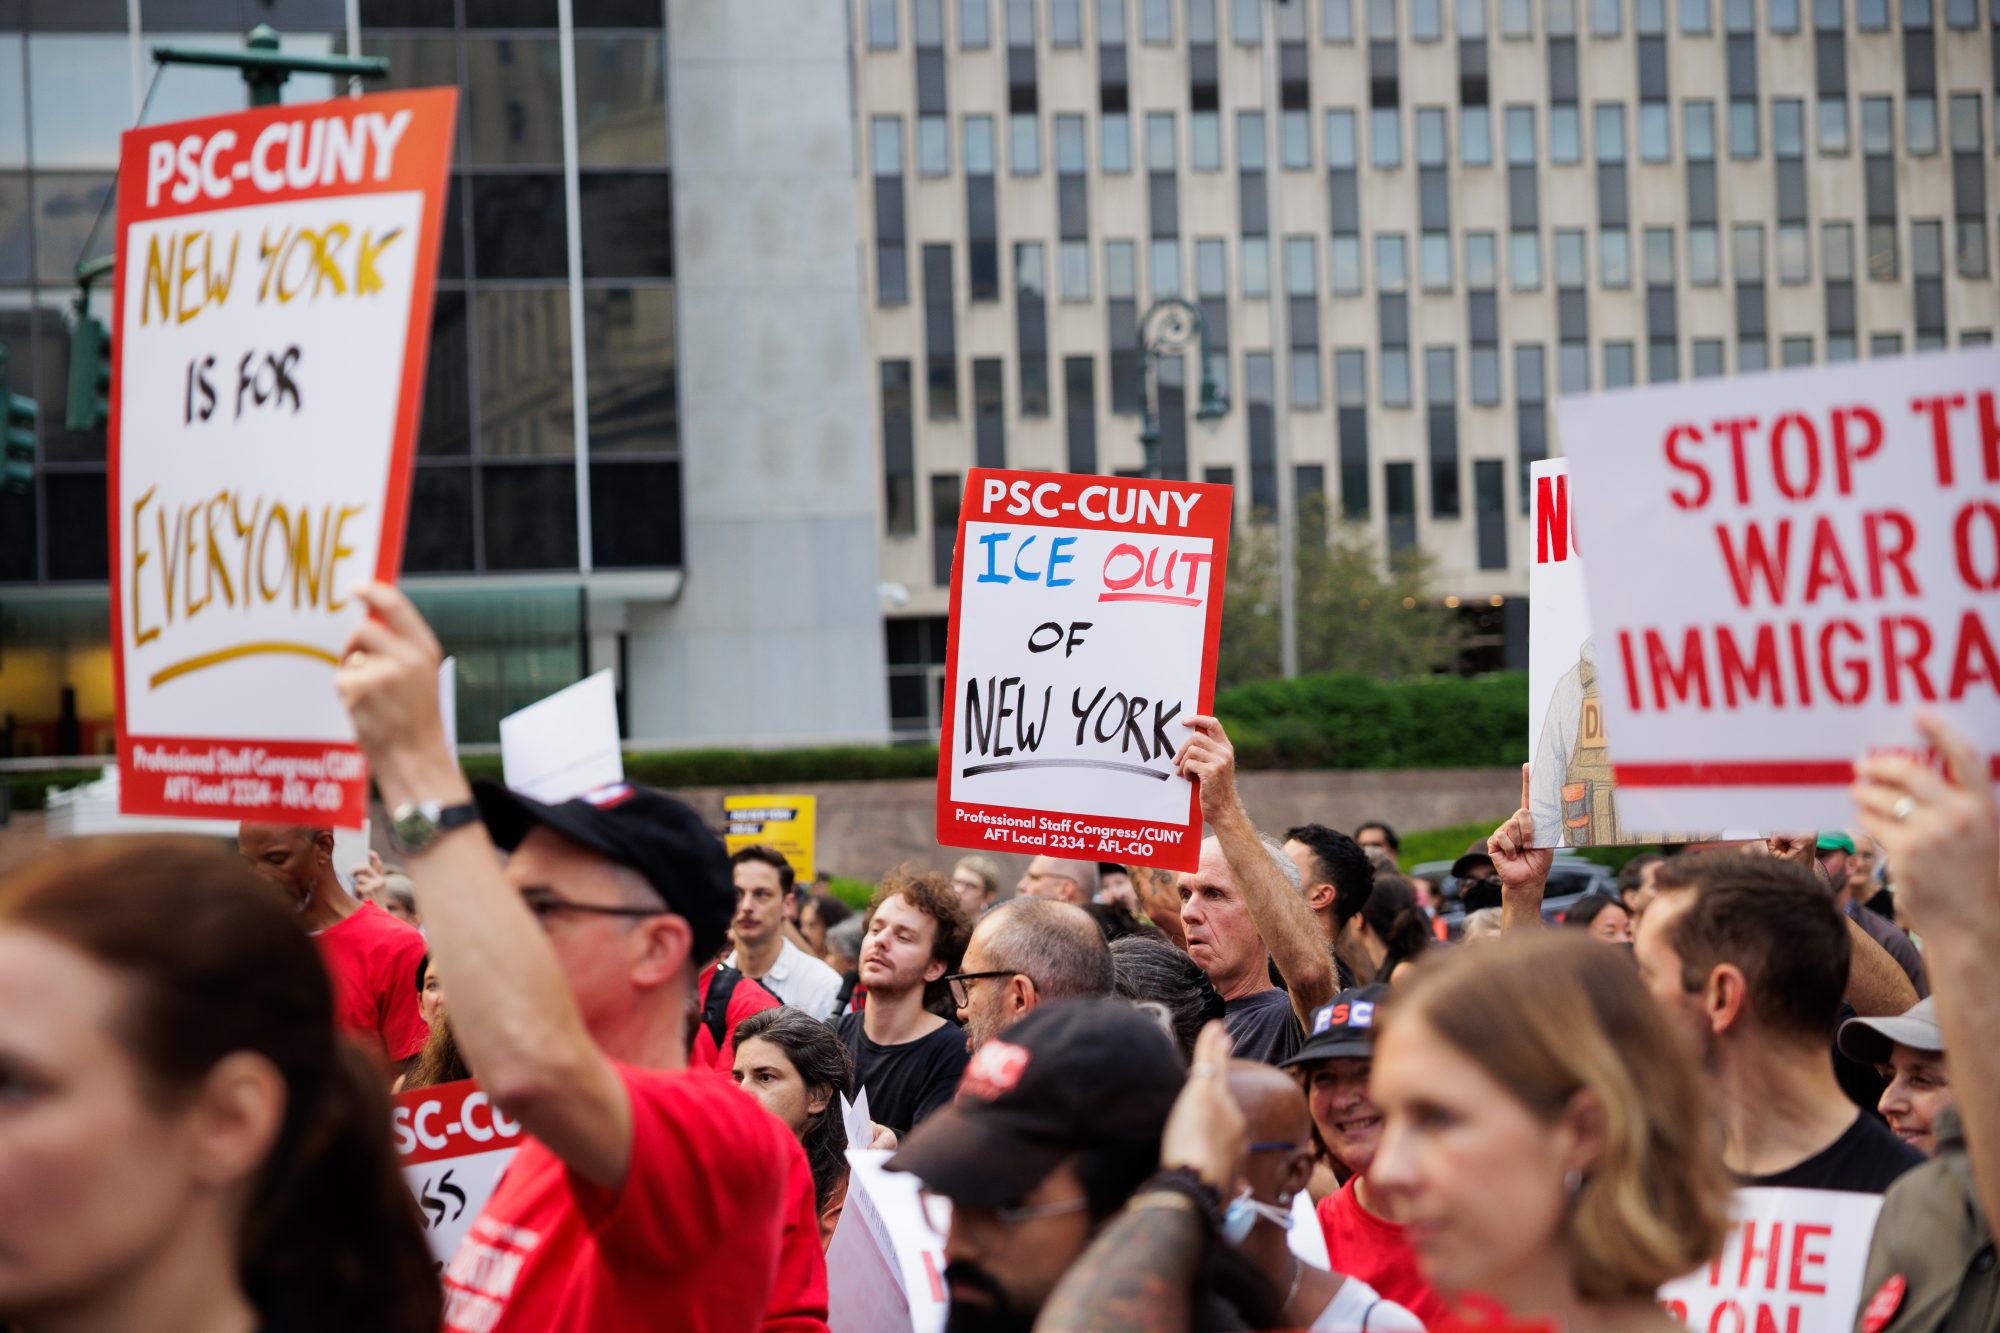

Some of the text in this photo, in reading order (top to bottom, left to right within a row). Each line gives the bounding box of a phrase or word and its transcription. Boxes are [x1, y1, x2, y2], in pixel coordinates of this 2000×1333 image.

[146, 109, 413, 207] PSC-CUNY
[140, 221, 403, 326] NEW YORK
[185, 345, 302, 426] IS FOR
[1664, 405, 1884, 511] STOP
[982, 478, 1202, 528] PSC-CUNY
[1538, 474, 1582, 563] N
[132, 483, 366, 648] EVERYONE
[977, 532, 1213, 596] ICE OUT
[1715, 507, 1921, 608] WAR
[1028, 621, 1094, 659] OF
[1619, 609, 2000, 711] IMMIGRA
[965, 675, 1182, 763] NEW YORK
[955, 808, 1184, 844] Professional Staff Congress/CUNY
[984, 827, 1009, 842] AFT
[1012, 831, 1046, 846] Local
[1050, 835, 1085, 850] 2334
[1097, 839, 1154, 857] AFL-CIO
[1313, 1001, 1371, 1035] PSC
